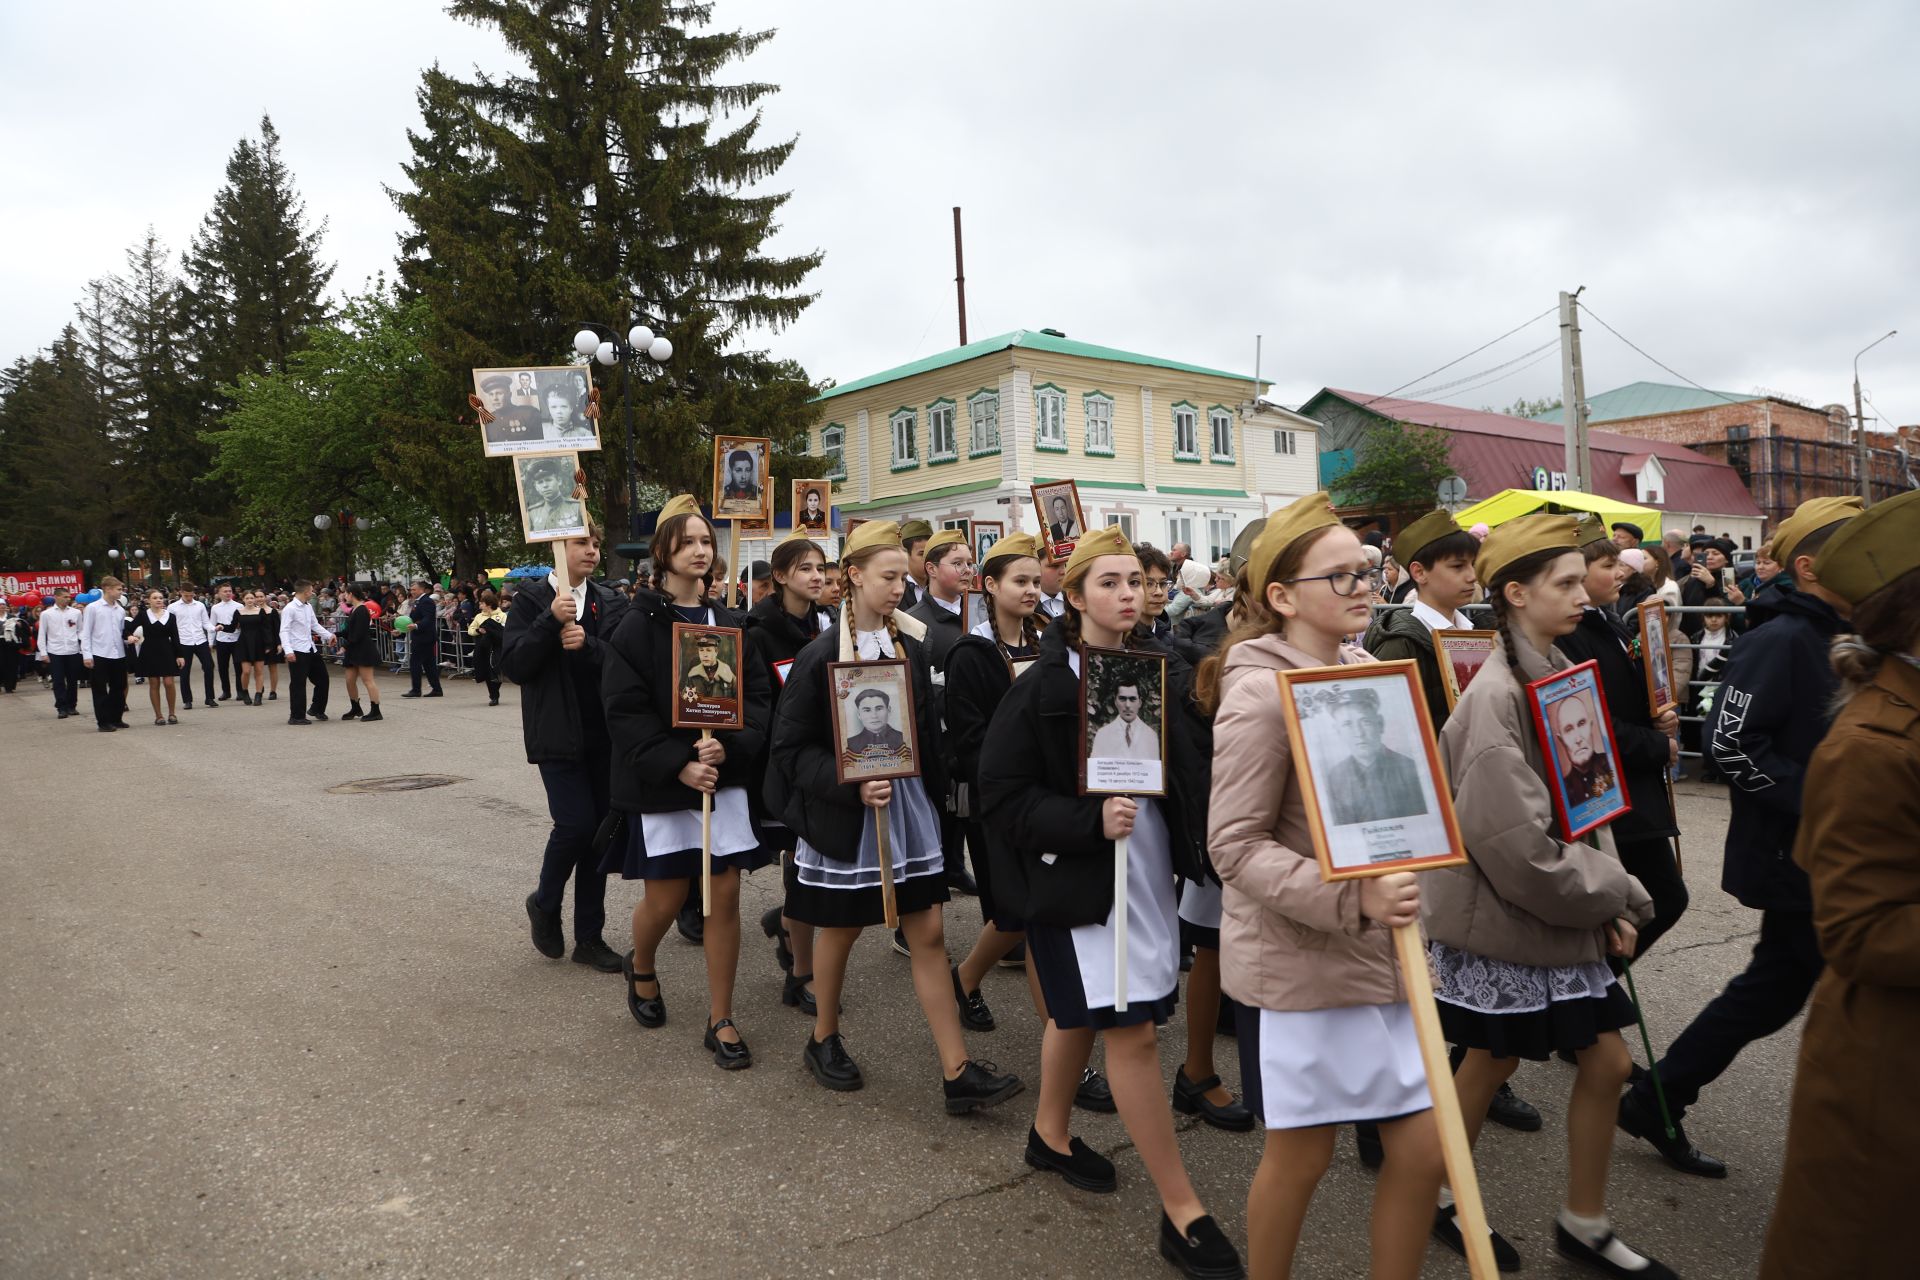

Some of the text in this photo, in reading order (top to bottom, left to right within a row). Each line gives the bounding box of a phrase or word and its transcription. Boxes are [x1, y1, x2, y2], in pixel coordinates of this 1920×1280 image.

[36, 574, 77, 585] ВЕЛИКОЙ
[19, 581, 37, 592] ЛЕТ
[1711, 685, 1776, 792] NIKE
